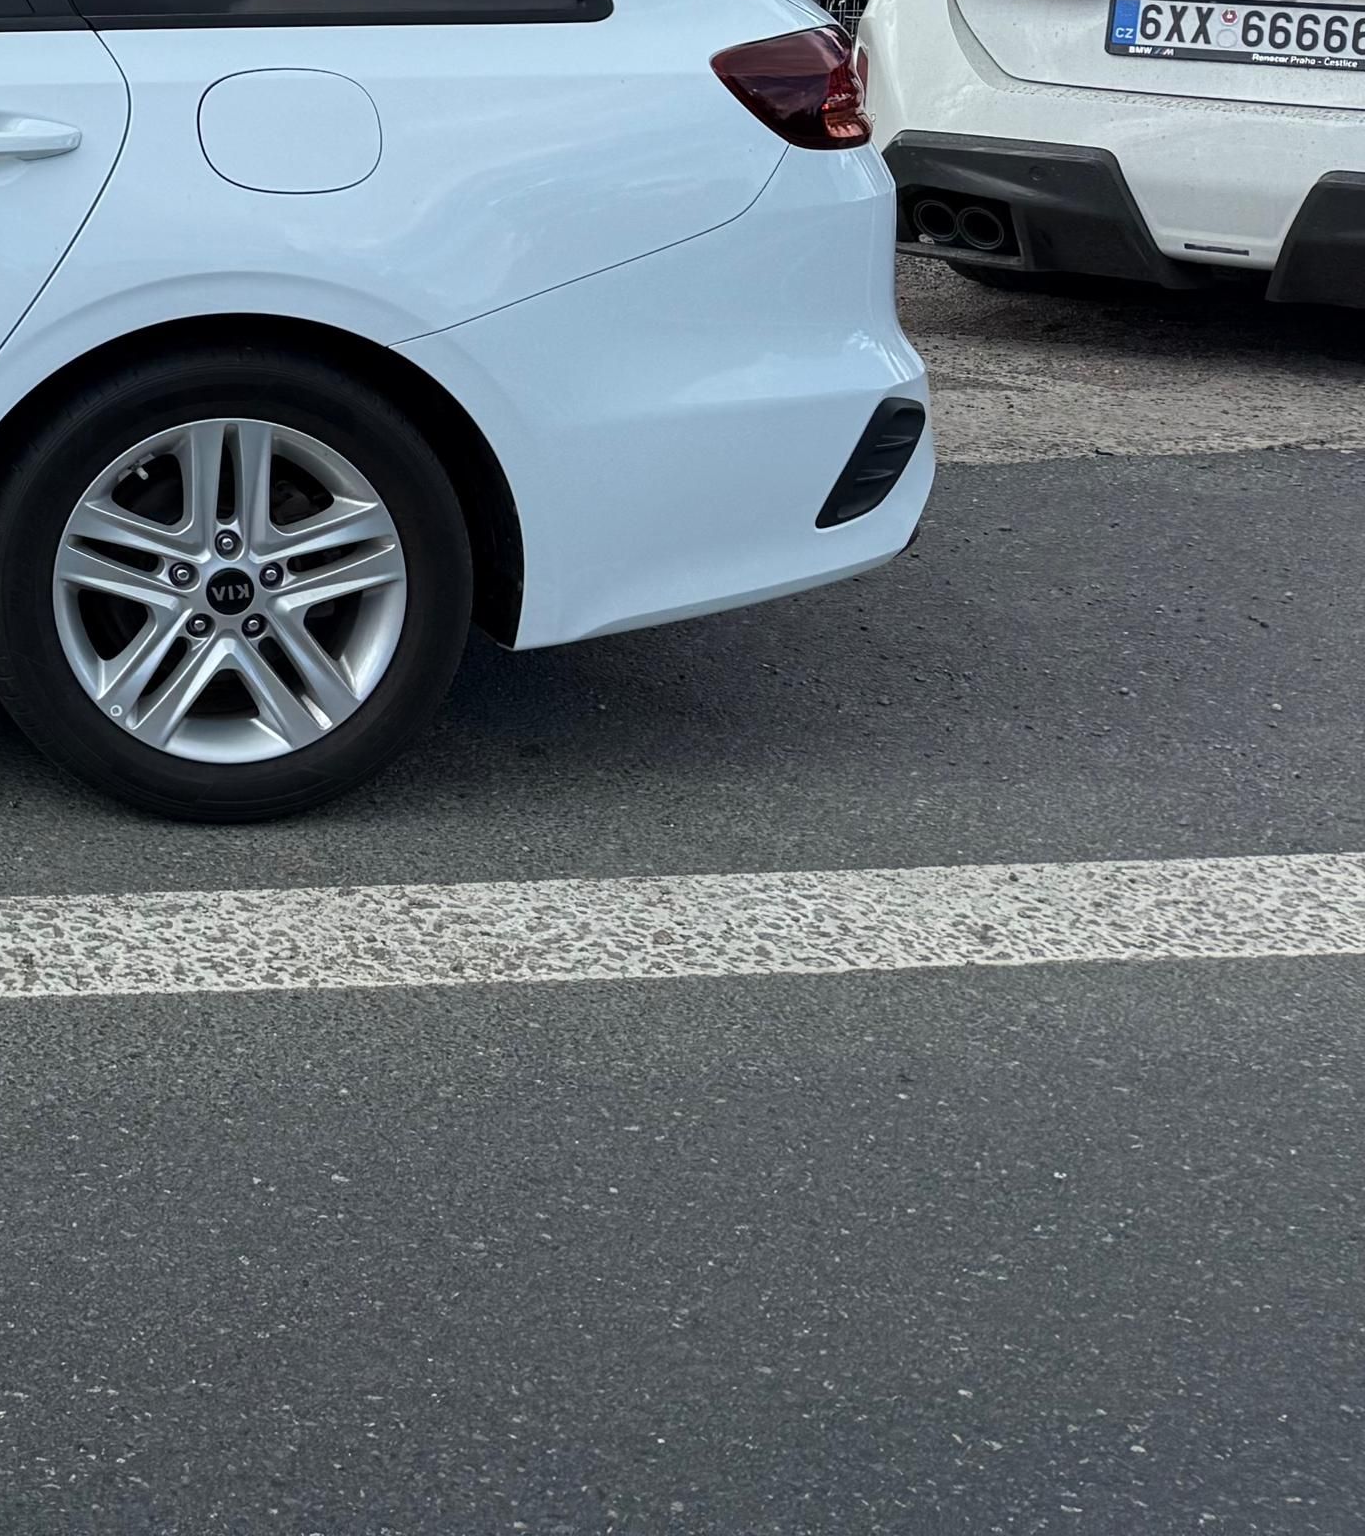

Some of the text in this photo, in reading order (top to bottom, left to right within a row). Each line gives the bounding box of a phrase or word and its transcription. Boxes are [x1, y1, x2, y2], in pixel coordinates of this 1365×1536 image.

[1139, 4, 1215, 45] 6XX
[1115, 27, 1134, 39] CZ
[1128, 46, 1153, 55] BMW
[211, 583, 250, 601] KIA
